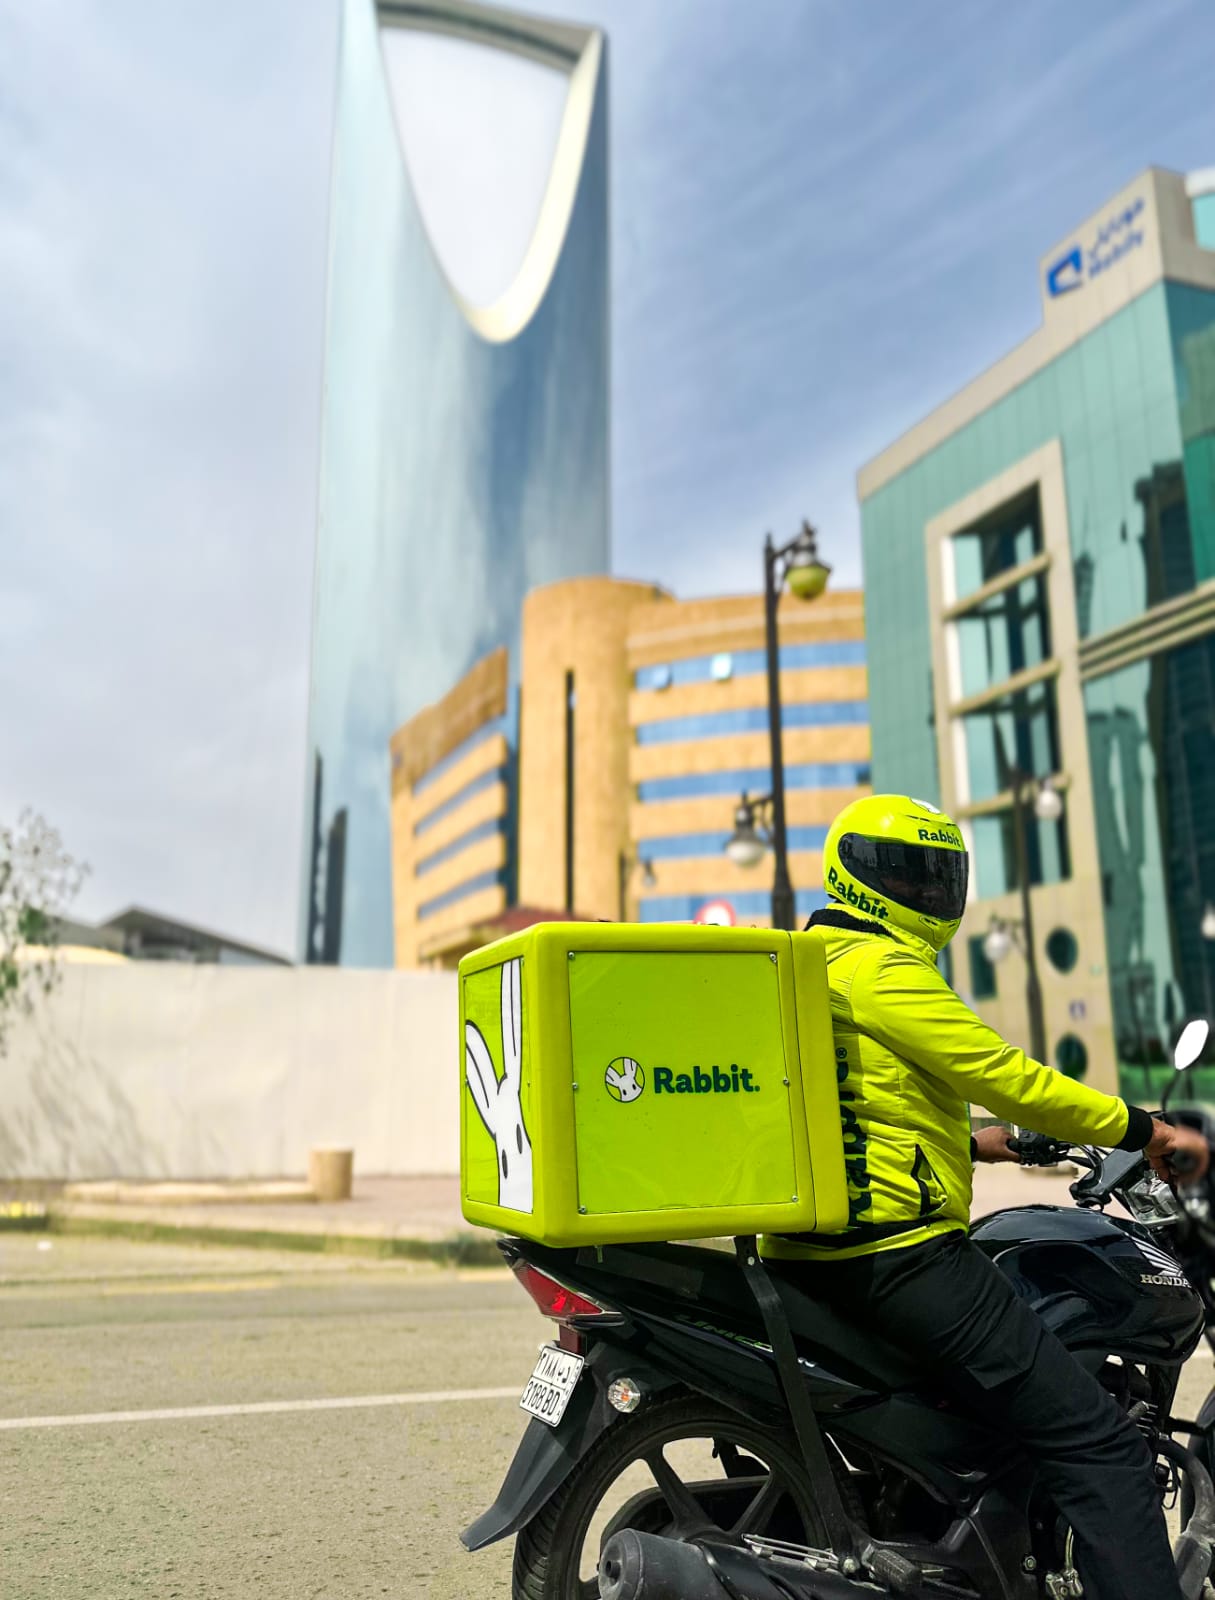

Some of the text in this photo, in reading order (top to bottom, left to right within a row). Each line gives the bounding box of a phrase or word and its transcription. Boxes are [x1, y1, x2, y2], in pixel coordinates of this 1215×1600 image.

[918, 829, 961, 847] Rabbit
[828, 866, 889, 920] Rabbit
[653, 1063, 761, 1094] Rabbit.
[1140, 1273, 1192, 1289] HONDA
[541, 1389, 561, 1416] BD
